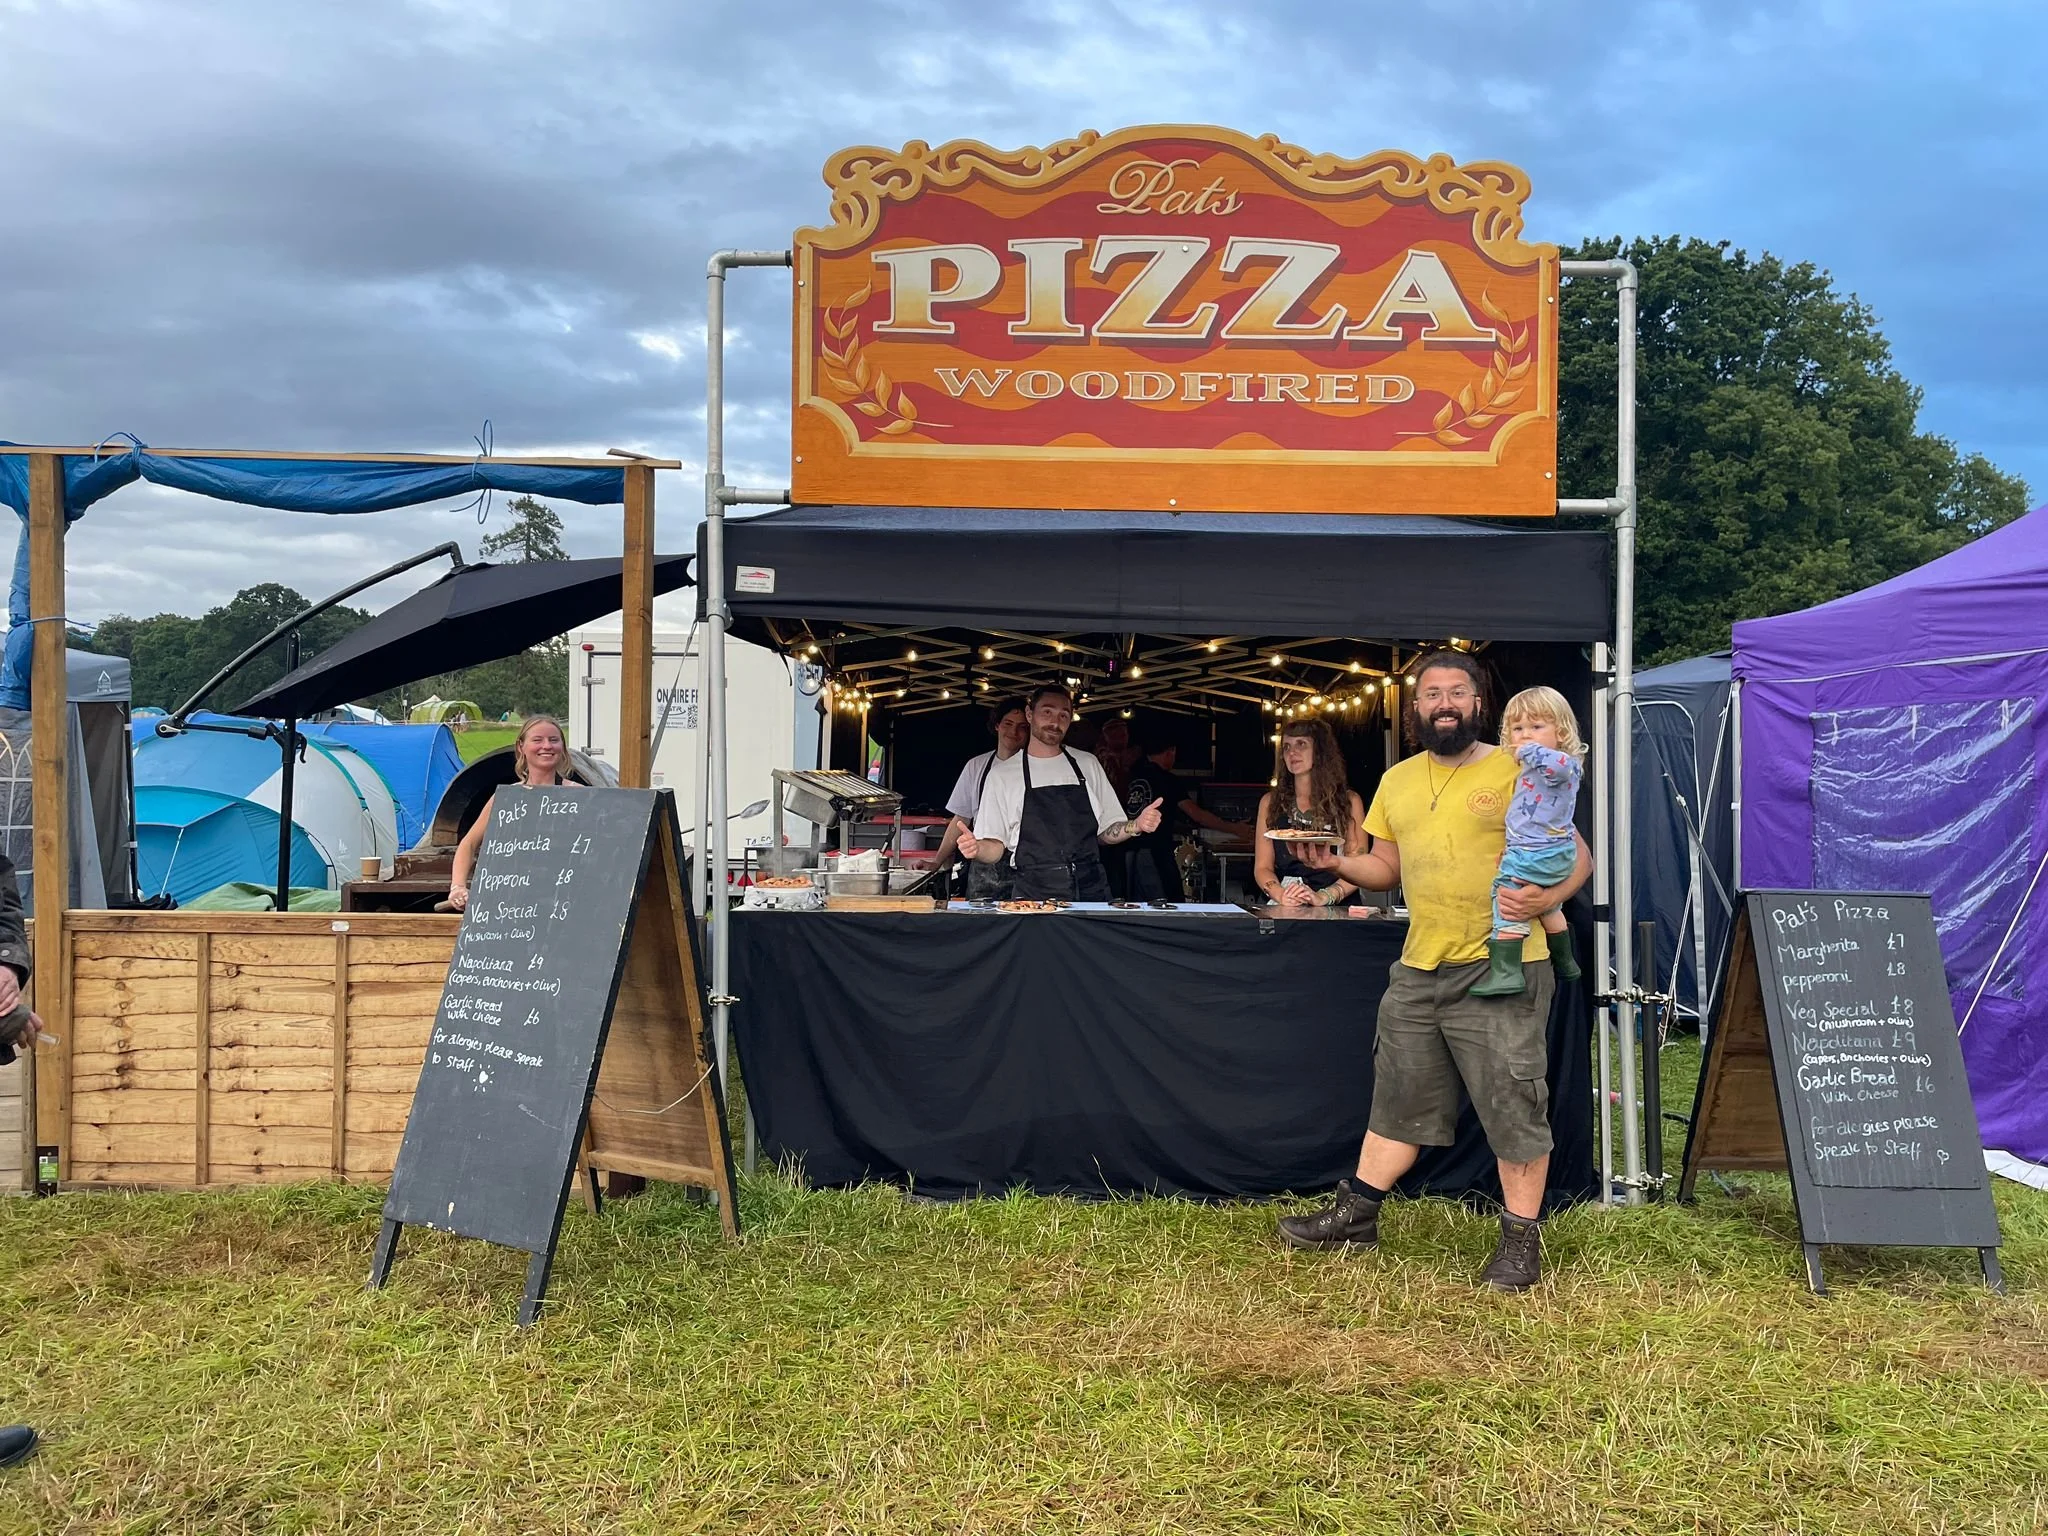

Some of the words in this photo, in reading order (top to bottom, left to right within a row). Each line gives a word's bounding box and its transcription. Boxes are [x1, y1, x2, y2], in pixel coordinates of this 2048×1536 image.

[1096, 158, 1244, 216] Pats
[871, 235, 1497, 342] PIZZA
[934, 367, 1416, 404] WOODFIRED
[656, 688, 669, 703] ON
[498, 799, 528, 828] Pat's
[539, 795, 579, 817] Pizza
[486, 834, 551, 857] Margherita
[570, 833, 592, 855] £7
[478, 867, 531, 894] Pepperoni
[555, 868, 574, 886] £8
[494, 901, 538, 924] Special
[549, 900, 570, 920] £8
[1772, 900, 1819, 933] Pat's
[1833, 899, 1891, 921] Pizza
[1777, 937, 1860, 965] Margherita
[1886, 932, 1905, 951] £7
[458, 953, 514, 973] Napolitana
[528, 953, 544, 971] £9
[1886, 961, 1906, 977] £8
[444, 993, 474, 1009] Garlic
[475, 998, 503, 1012] Bread
[1785, 999, 1818, 1028] Veg
[1823, 1000, 1880, 1020] Special
[1890, 994, 1914, 1016] £8
[447, 1008, 469, 1020] with
[472, 1012, 502, 1026] cheese
[523, 1007, 540, 1026] £6
[1818, 1018, 1877, 1032] (mushroom
[432, 1027, 448, 1046] for
[448, 1033, 482, 1051] alergies
[484, 1041, 514, 1059] please
[1791, 1031, 1884, 1055] Napolitana
[1891, 1029, 1917, 1050] £9
[432, 1051, 442, 1064] to
[1797, 1065, 1846, 1091] Garlic
[1915, 1075, 1936, 1094] £6
[1893, 1115, 1939, 1135] please
[1864, 1140, 1879, 1156] to
